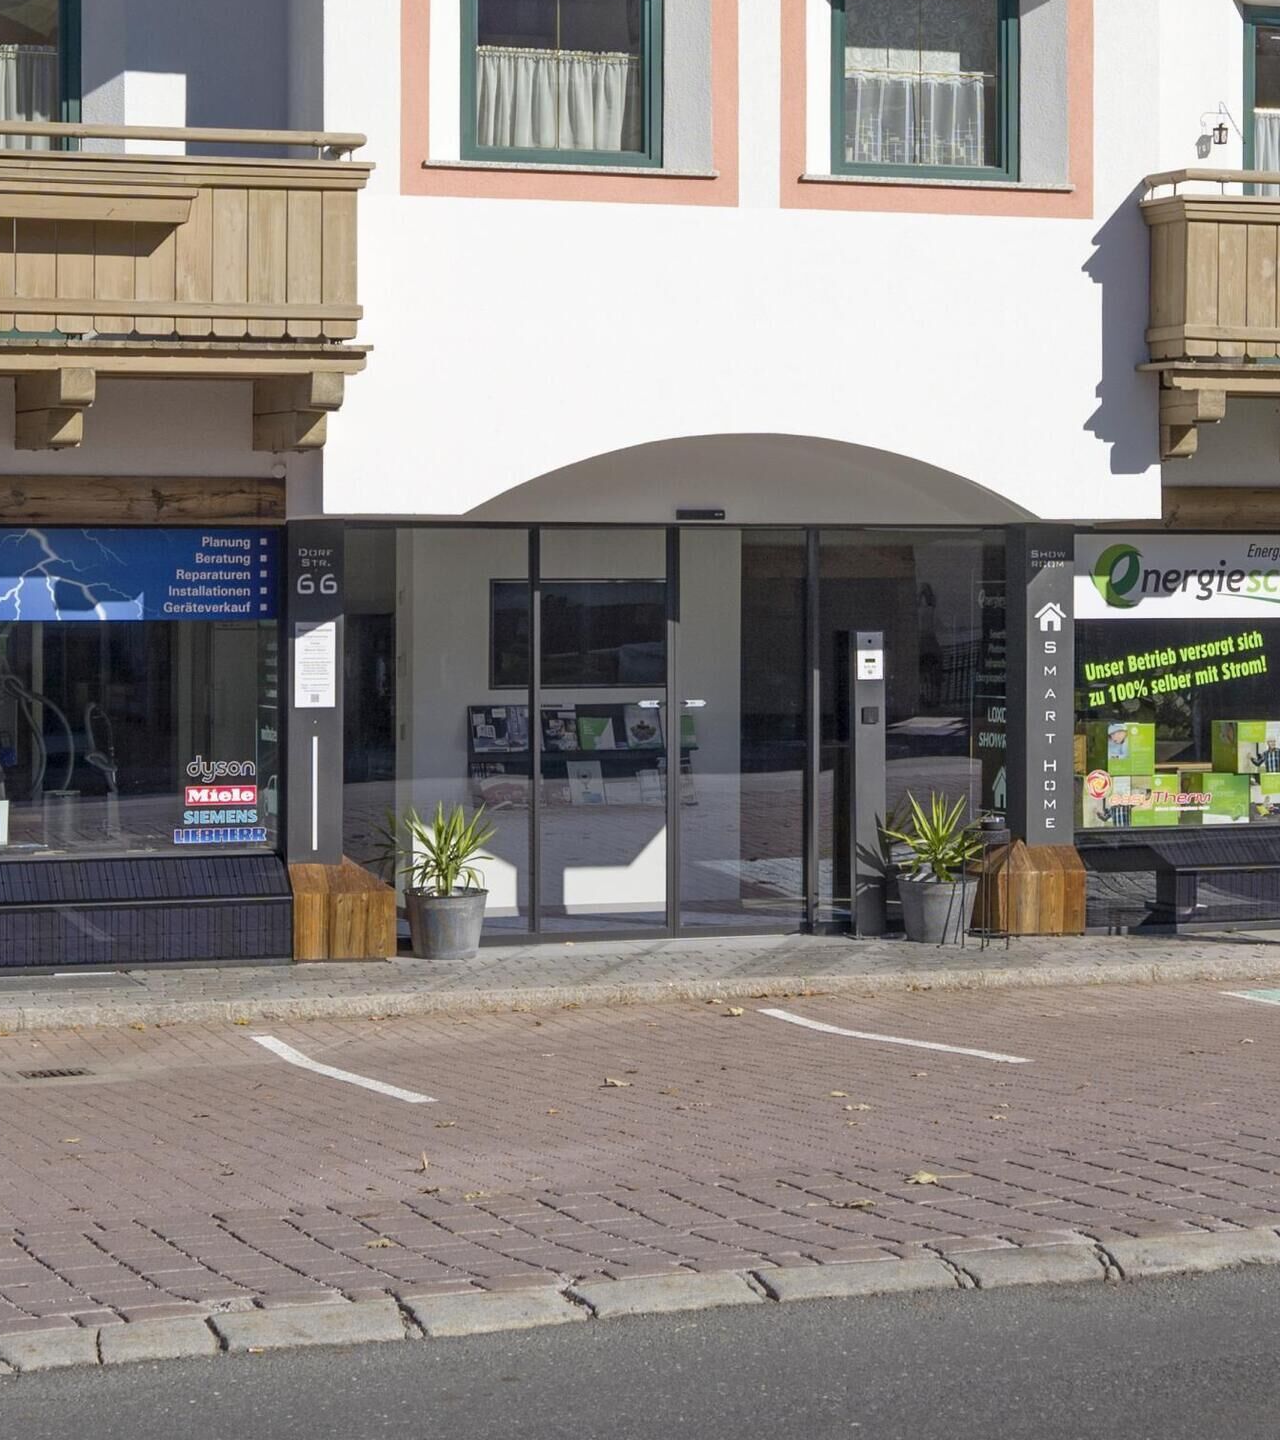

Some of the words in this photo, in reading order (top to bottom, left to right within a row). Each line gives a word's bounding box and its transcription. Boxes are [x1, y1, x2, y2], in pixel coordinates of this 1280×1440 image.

[202, 536, 251, 550] Planung
[195, 553, 251, 566] Beratung
[176, 569, 251, 582] Reparaturen
[168, 586, 251, 597] Installationen
[297, 574, 338, 595] 66
[163, 601, 251, 614] Geräteverkauf
[1085, 660, 1125, 681] Unser
[1127, 648, 1177, 673] Betrieb
[1179, 637, 1235, 662] versorgt
[1238, 630, 1263, 652] sich
[1088, 691, 1105, 707] zu
[1108, 679, 1148, 704] 100%
[1151, 673, 1191, 695] selber
[1195, 666, 1219, 686] mit
[1221, 655, 1267, 680] Strom!
[1044, 641, 1057, 744] SMART
[186, 755, 256, 783] dyson
[187, 788, 255, 803] Miele
[1043, 759, 1057, 829] HOME
[184, 809, 257, 825] SIEMENS
[174, 827, 267, 844] LIEBHERR
